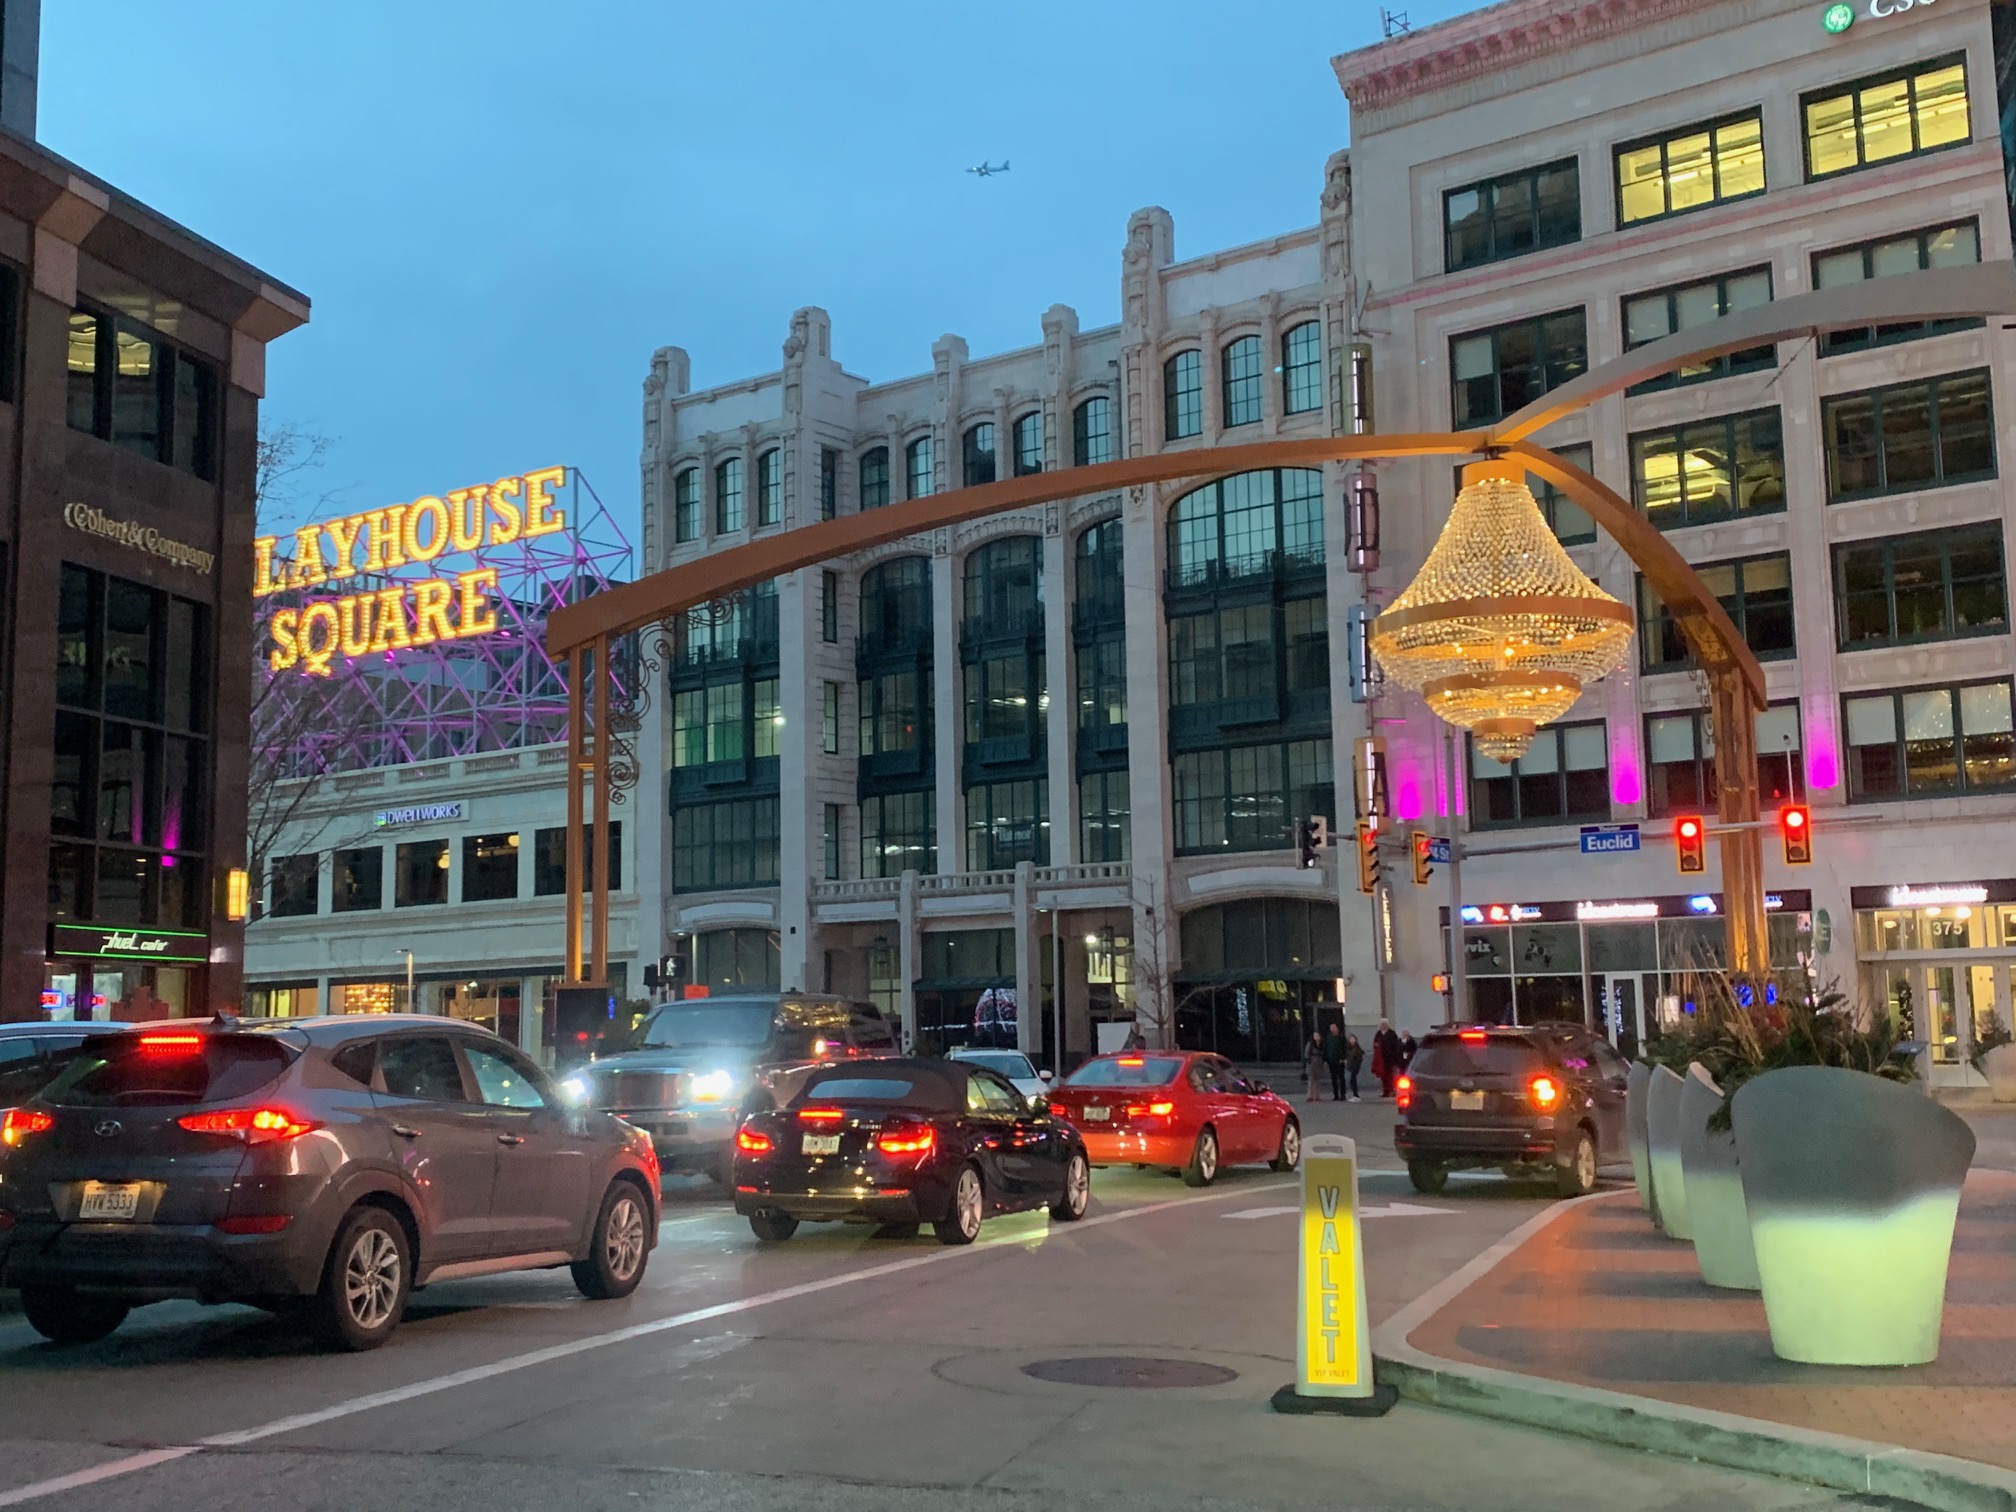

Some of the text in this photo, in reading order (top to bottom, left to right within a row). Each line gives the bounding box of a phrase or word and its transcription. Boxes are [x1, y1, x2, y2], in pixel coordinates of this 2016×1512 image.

[136, 526, 215, 574] Company
[270, 567, 499, 677] SQUARE
[1586, 833, 1634, 851] Euclid
[1317, 1185, 1341, 1364] VALET
[1328, 1368, 1351, 1379] VALET
